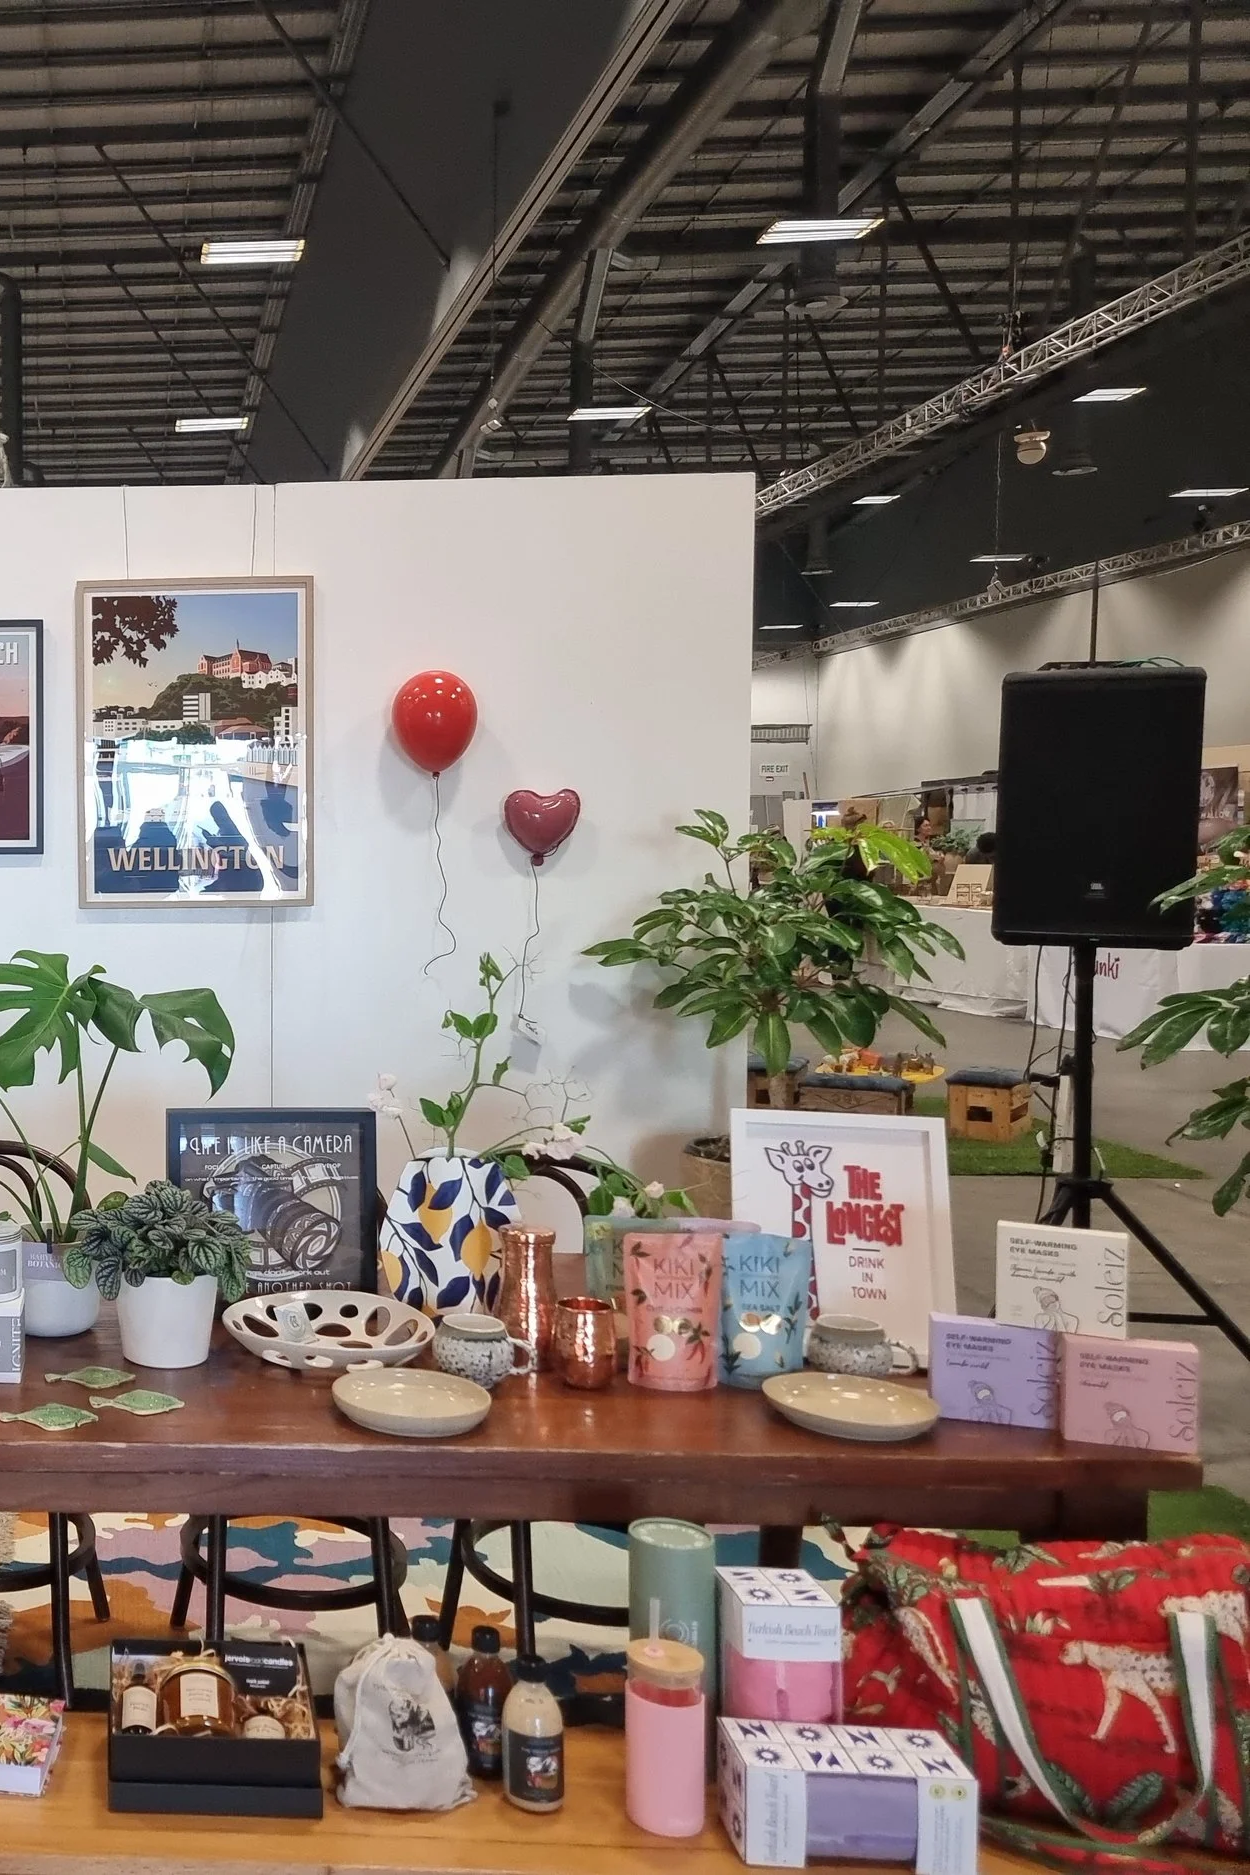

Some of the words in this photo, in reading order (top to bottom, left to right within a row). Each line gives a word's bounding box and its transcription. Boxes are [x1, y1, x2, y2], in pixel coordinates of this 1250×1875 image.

[761, 764, 774, 773] FIRE
[775, 764, 788, 773] EXIT
[107, 845, 285, 872] WELLINGTON
[244, 1136, 271, 1154] LIKE
[278, 1136, 287, 1154] A
[292, 1134, 352, 1153] CAMERA
[843, 1165, 882, 1201] THE
[825, 1201, 905, 1247] LONGEST
[1009, 1237, 1078, 1251] SELF-WARMING
[1009, 1246, 1026, 1254] EYE
[1028, 1248, 1059, 1258] MASKS
[653, 1257, 695, 1276] KIKI
[739, 1255, 780, 1274] KIKI
[848, 1255, 885, 1269] DRINK
[861, 1272, 874, 1284] IN
[653, 1281, 695, 1299] MIX
[740, 1280, 781, 1299] MIX
[851, 1286, 887, 1301] TOWN
